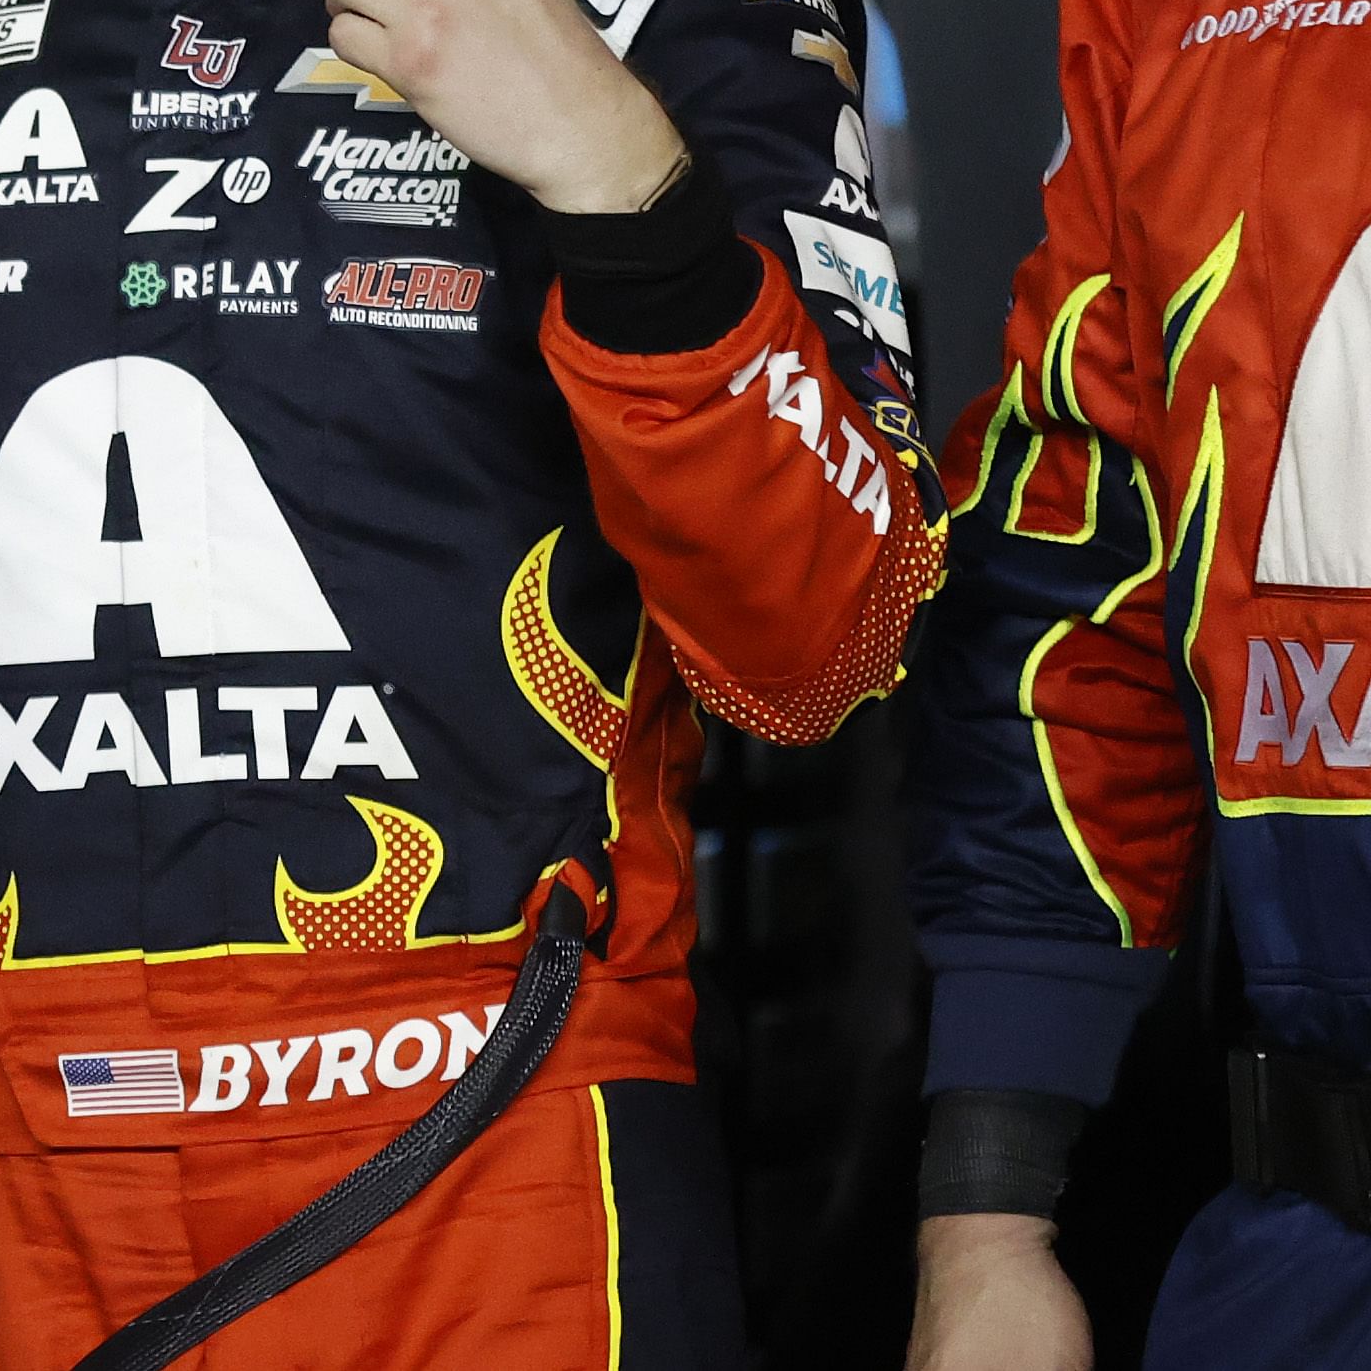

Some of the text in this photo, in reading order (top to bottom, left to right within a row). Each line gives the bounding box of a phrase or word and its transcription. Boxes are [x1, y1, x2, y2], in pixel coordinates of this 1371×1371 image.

[130, 115, 253, 131] UNIVERSITY
[131, 92, 258, 118] LIBERTY
[124, 158, 225, 234] Z
[323, 169, 461, 204] Cars.com
[819, 177, 879, 221] AX
[173, 259, 300, 299] RELAY
[327, 260, 485, 312] ALL-PRO
[219, 299, 299, 315] PAYMENTS
[329, 310, 478, 332] AUTO RECONDITIONING
[1234, 638, 1371, 768] AX
[187, 1003, 508, 1113] BYRON
